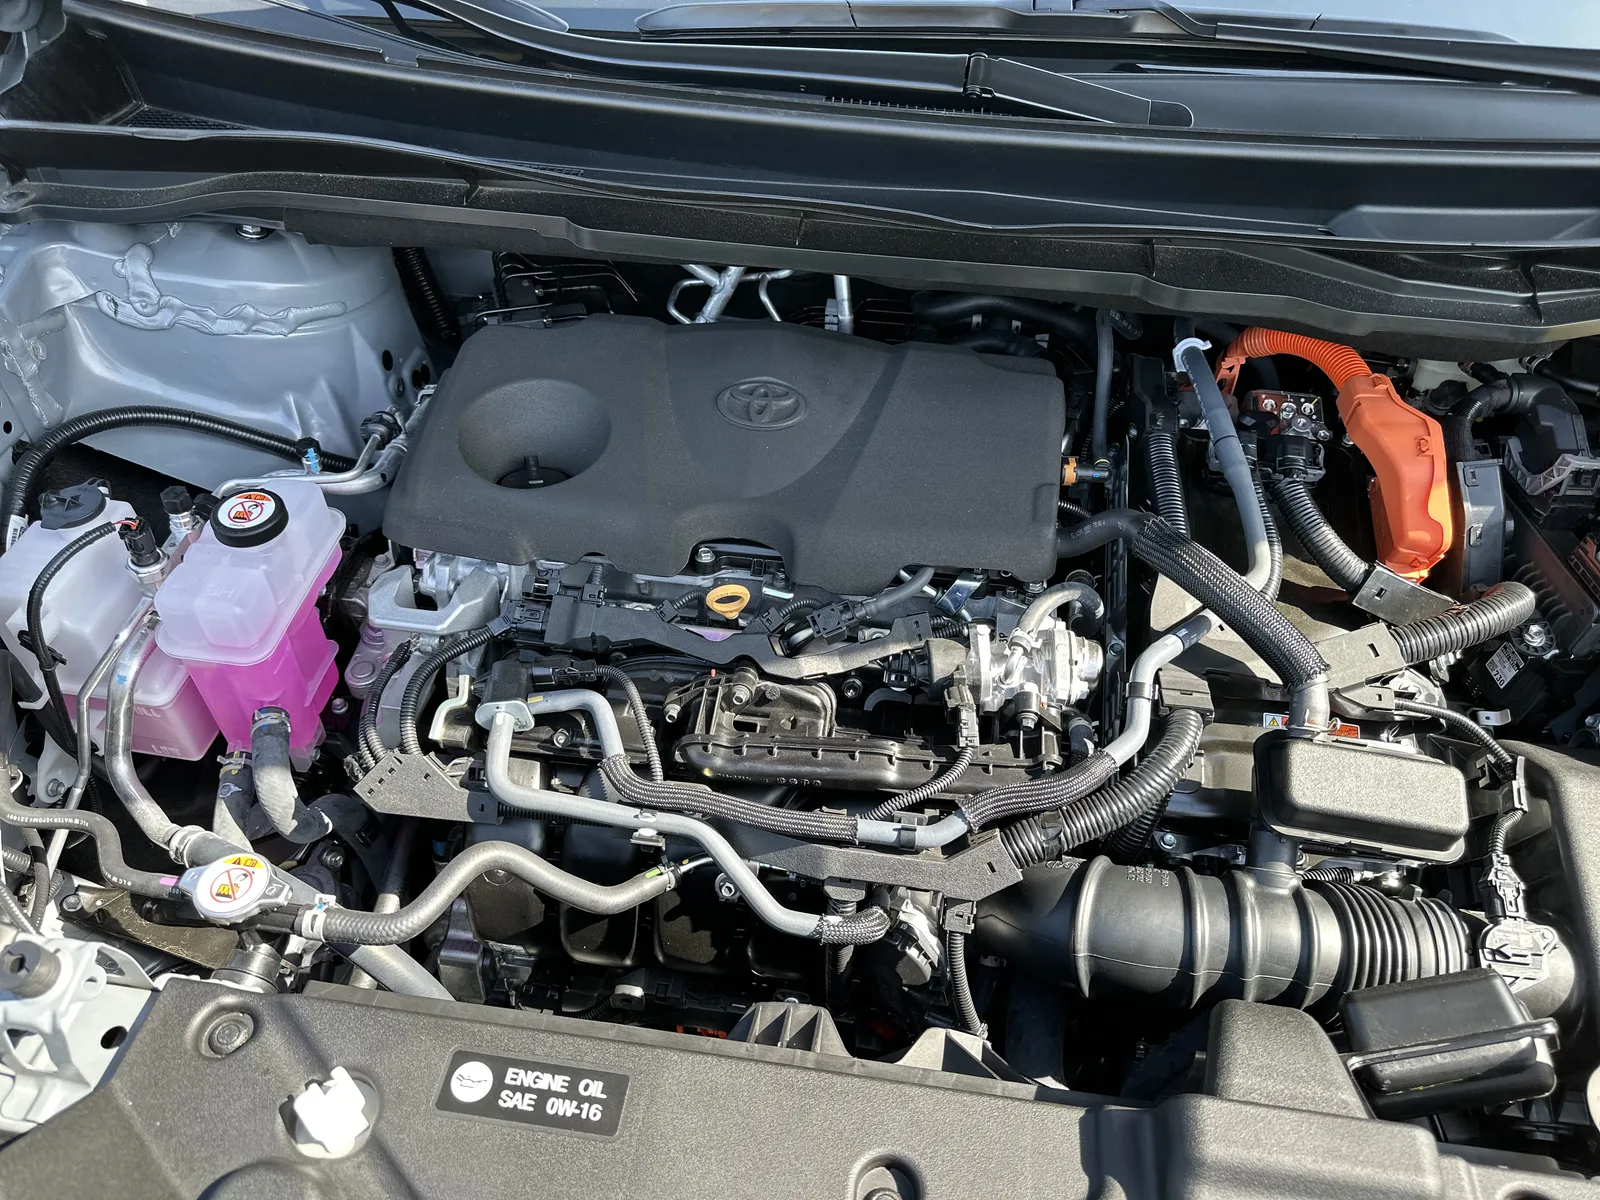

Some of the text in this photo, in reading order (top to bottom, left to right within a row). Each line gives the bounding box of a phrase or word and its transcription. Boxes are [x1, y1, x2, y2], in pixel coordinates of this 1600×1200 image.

[504, 1067, 607, 1099] ENGINE OIL
[498, 1090, 603, 1122] SAE 0W-16
